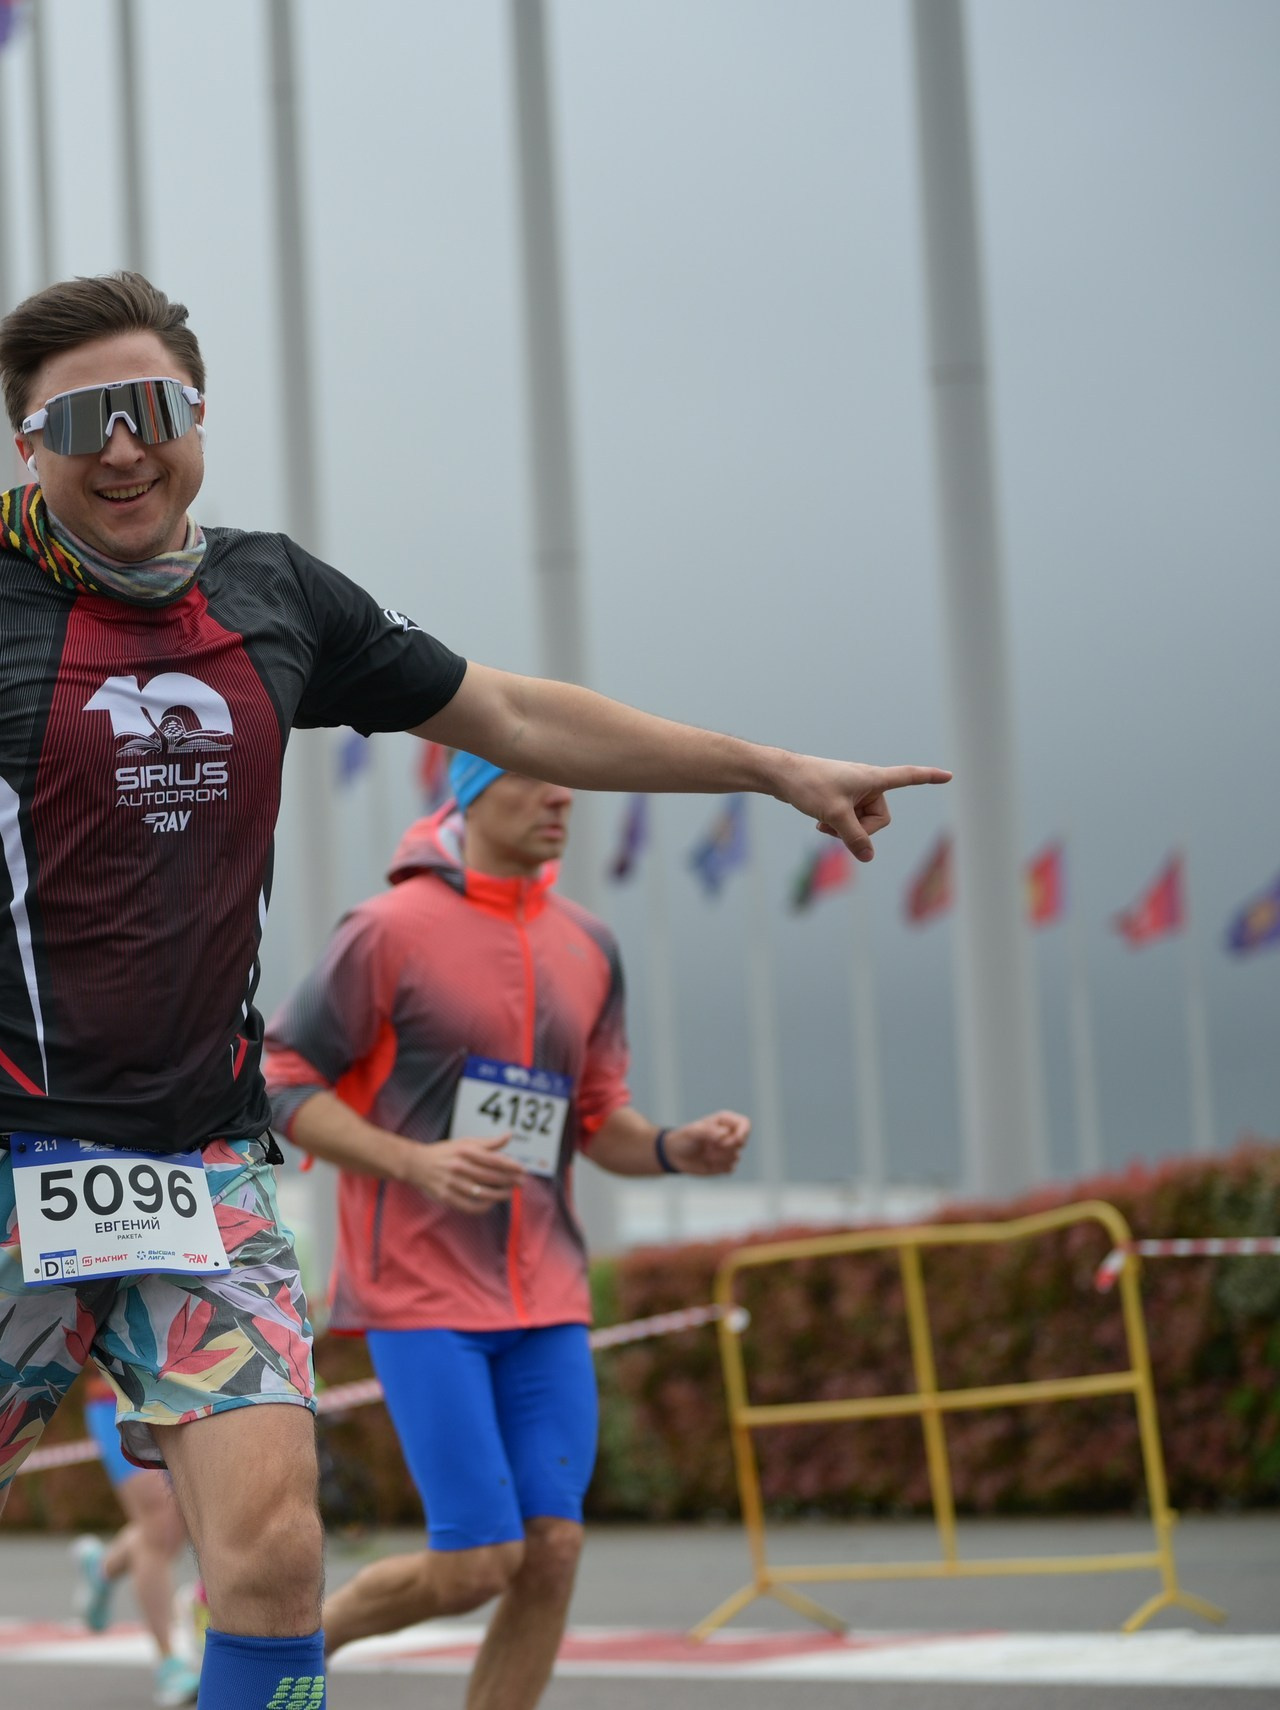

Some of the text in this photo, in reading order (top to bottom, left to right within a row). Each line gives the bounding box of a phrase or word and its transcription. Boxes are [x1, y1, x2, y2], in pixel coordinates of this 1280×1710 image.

[115, 761, 228, 790] SIRIUS
[115, 788, 227, 807] AUTODROM
[142, 810, 192, 833] RAY
[479, 1091, 554, 1135] 4132
[34, 1139, 57, 1153] 21.1
[39, 1164, 197, 1221] 5096
[95, 1217, 160, 1234] ЕВГЕНИЙ
[95, 1254, 128, 1263] МАГНИТ
[182, 1253, 208, 1263] RAY
[45, 1261, 59, 1277] D
